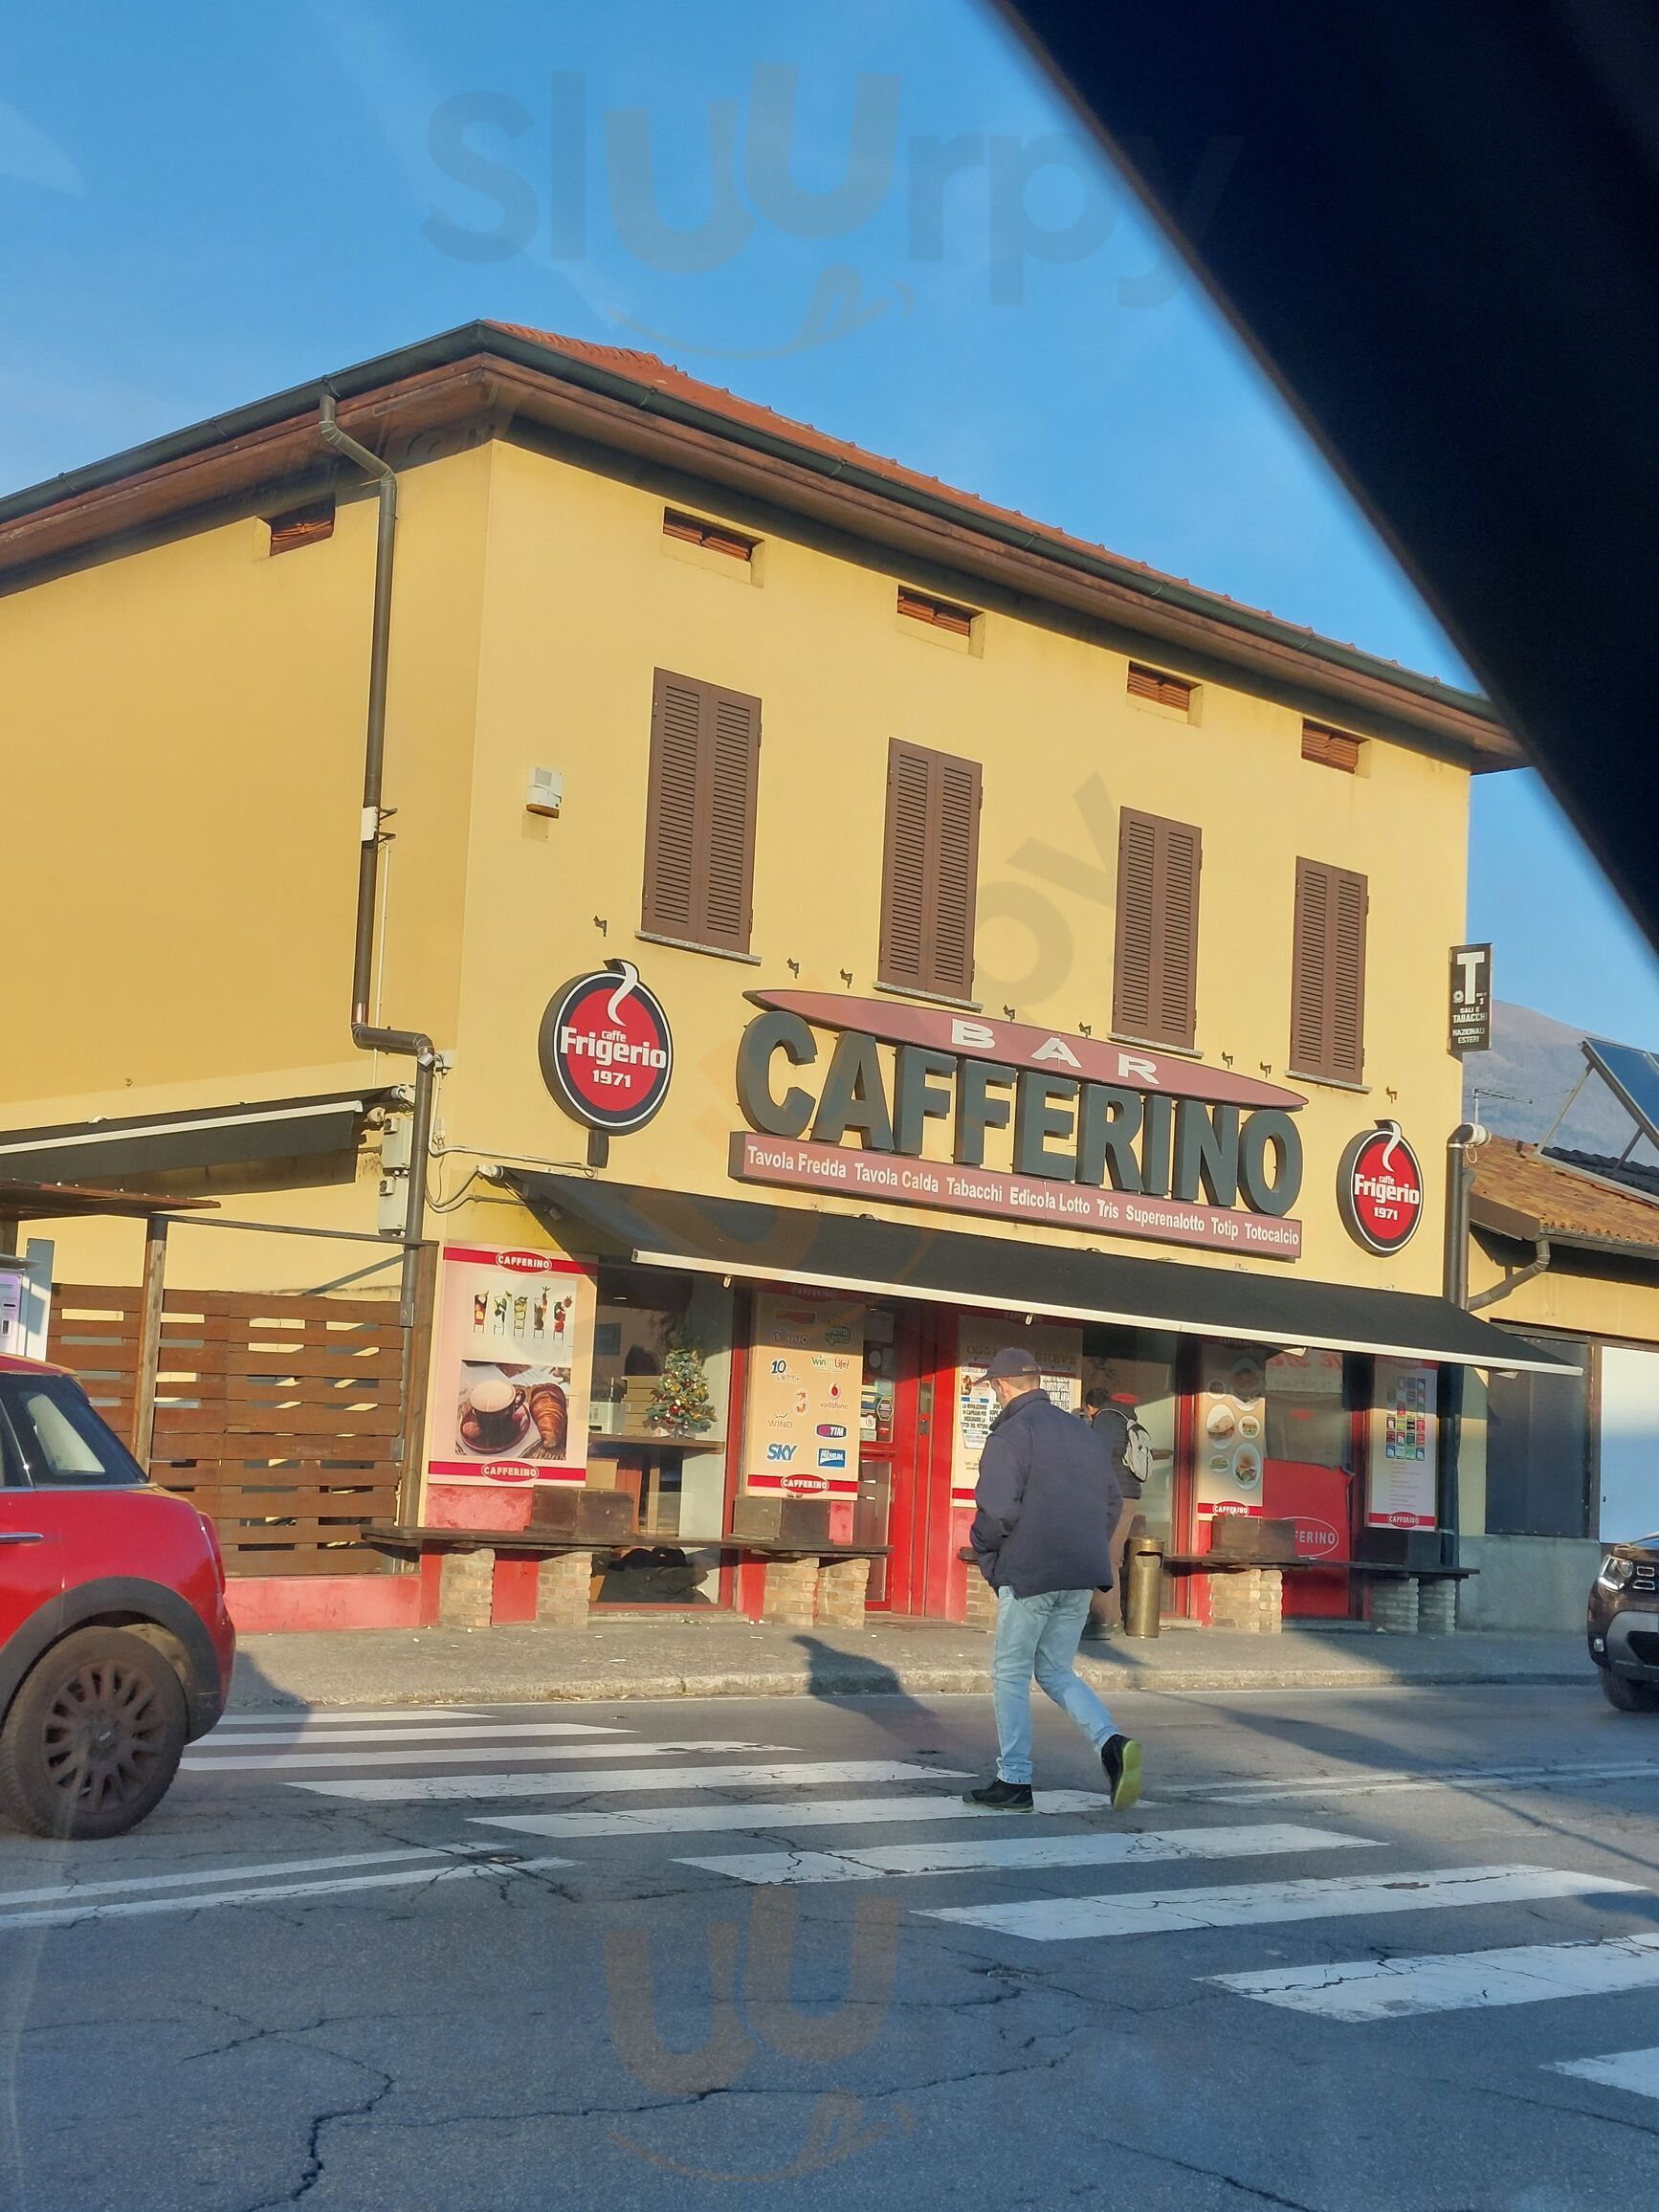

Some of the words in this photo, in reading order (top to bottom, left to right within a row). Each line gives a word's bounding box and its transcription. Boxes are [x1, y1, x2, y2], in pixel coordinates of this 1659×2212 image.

[1456, 951, 1485, 1005] T
[560, 1026, 667, 1069] Frigerio
[952, 1018, 1161, 1086] BAR
[592, 1070, 631, 1088] 1971
[736, 1010, 1303, 1218] CAFFERINO
[747, 1145, 794, 1171] Tavola
[797, 1152, 847, 1179] Fredda
[854, 1162, 898, 1187] Tavola
[901, 1170, 940, 1194] Calda
[946, 1177, 1003, 1204] Tabacchi
[1009, 1186, 1056, 1211] Edicola
[1058, 1194, 1091, 1215] Lotto
[1096, 1198, 1119, 1219] Tris
[1125, 1204, 1206, 1232] Superenalotto
[1210, 1216, 1239, 1242] Totip
[1245, 1223, 1299, 1246] Totocalcio
[1354, 1173, 1420, 1206] Frigerio
[1373, 1206, 1399, 1221] 1971
[498, 1255, 550, 1269] CAFFERINO
[771, 1360, 786, 1374] 10
[768, 1420, 792, 1428] WIND
[766, 1443, 798, 1461] SKY
[483, 1466, 537, 1477] CAFFERINO
[782, 1479, 828, 1490] CAFFERINO
